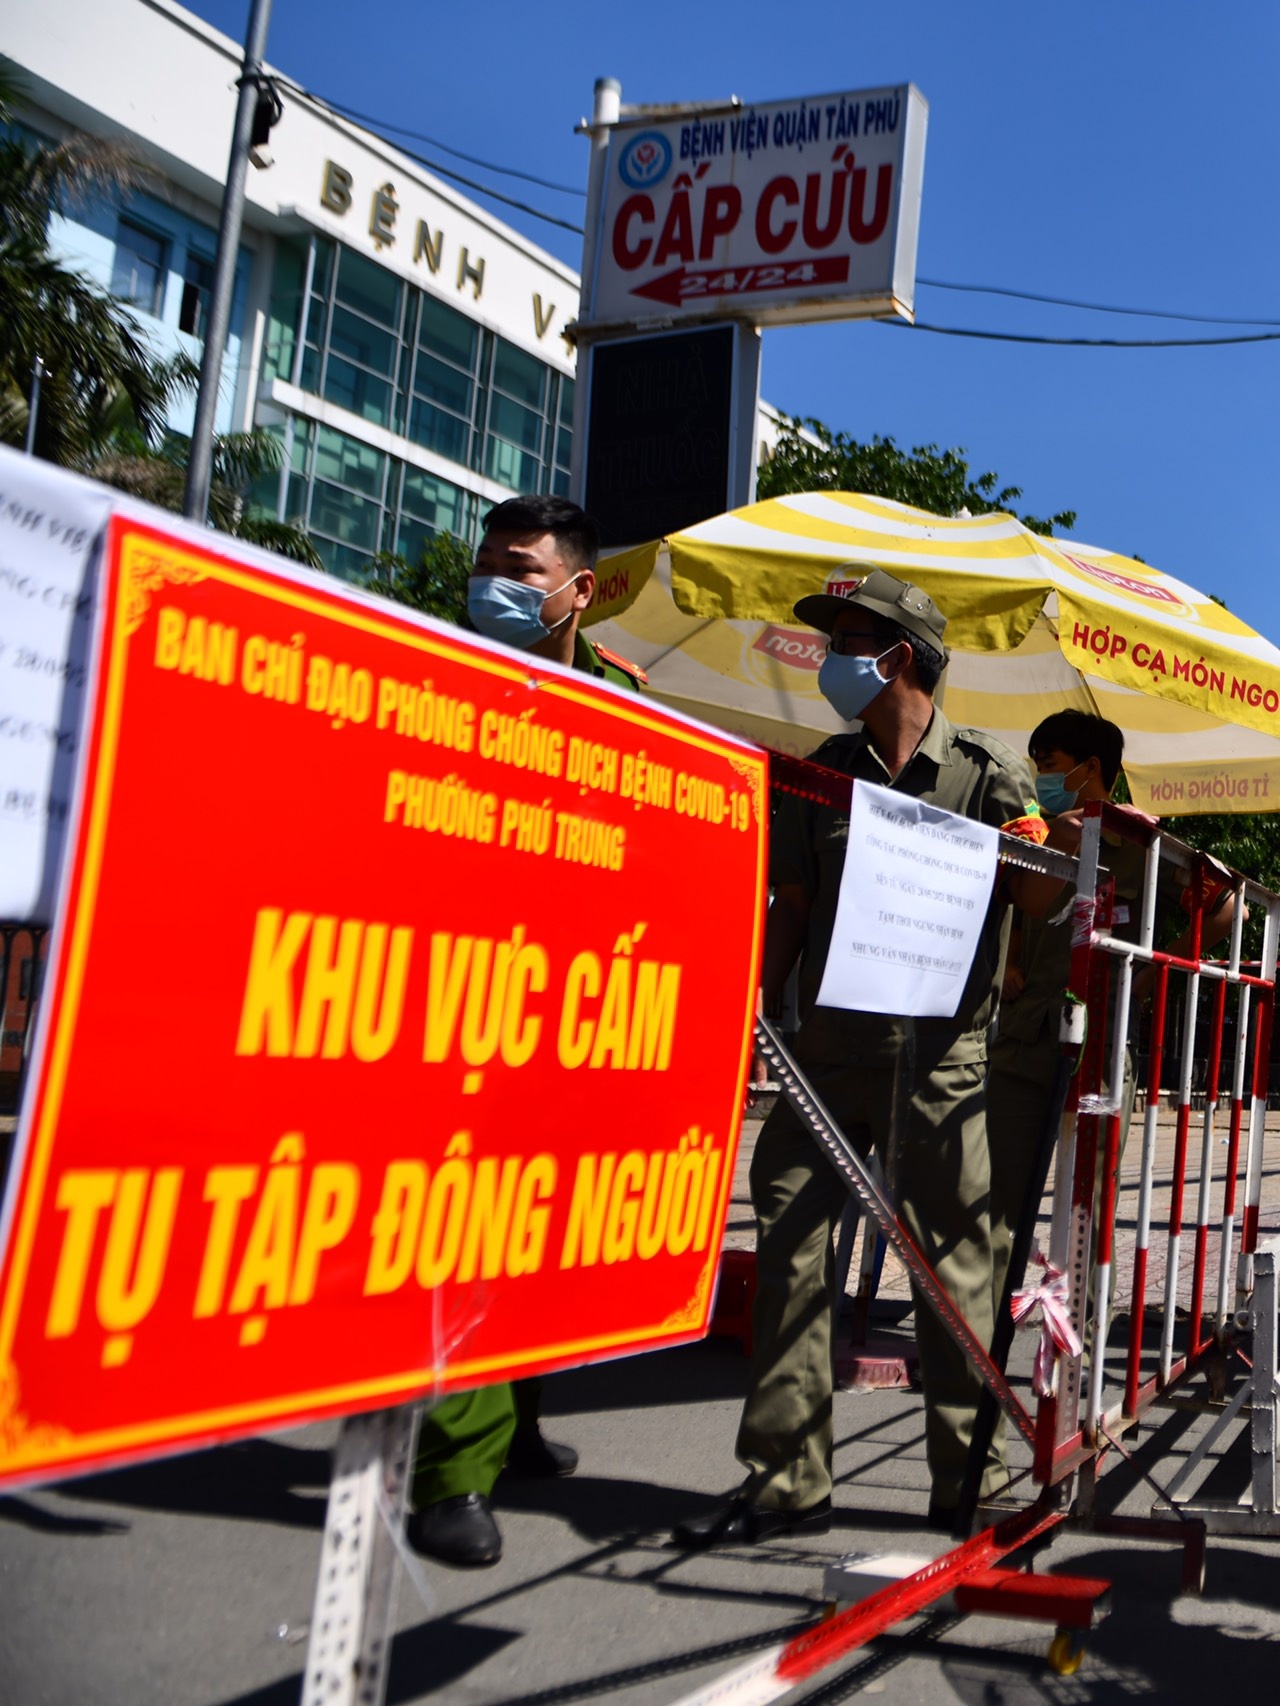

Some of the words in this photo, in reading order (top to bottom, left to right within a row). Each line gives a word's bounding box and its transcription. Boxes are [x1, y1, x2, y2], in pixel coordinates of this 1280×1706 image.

[680, 118, 725, 166] BỆNH
[730, 110, 769, 160] VIỆN
[772, 101, 820, 152] QUẬN
[826, 96, 859, 139] TÂN
[863, 88, 901, 134] PHÚ
[320, 158, 486, 302] BỆNH
[612, 162, 742, 271] CẤP
[755, 144, 893, 256] CỨU
[680, 263, 817, 295] 24/24
[154, 605, 239, 686] BAN
[241, 632, 306, 705] CHỈ
[306, 654, 374, 730] ĐẠO
[376, 678, 476, 753] PHÒNG
[478, 708, 564, 778] CHỐNG
[566, 735, 619, 796] DỊCH
[620, 750, 674, 811] BỆNH
[674, 772, 750, 833] COVID-19
[1072, 621, 1127, 664] HỢP
[1131, 643, 1167, 683] CẠ
[1173, 656, 1226, 695] MÓN
[499, 798, 553, 855] PHÚ
[554, 812, 627, 872] TRUNG
[236, 907, 414, 1064] KHU
[422, 924, 549, 1095] VỰC
[557, 922, 681, 1071] CẤM
[45, 1166, 184, 1368] TỤ
[192, 1131, 361, 1347] TẬP
[363, 1131, 556, 1296] ĐÔNG
[559, 1125, 722, 1270] NGƯỜI
